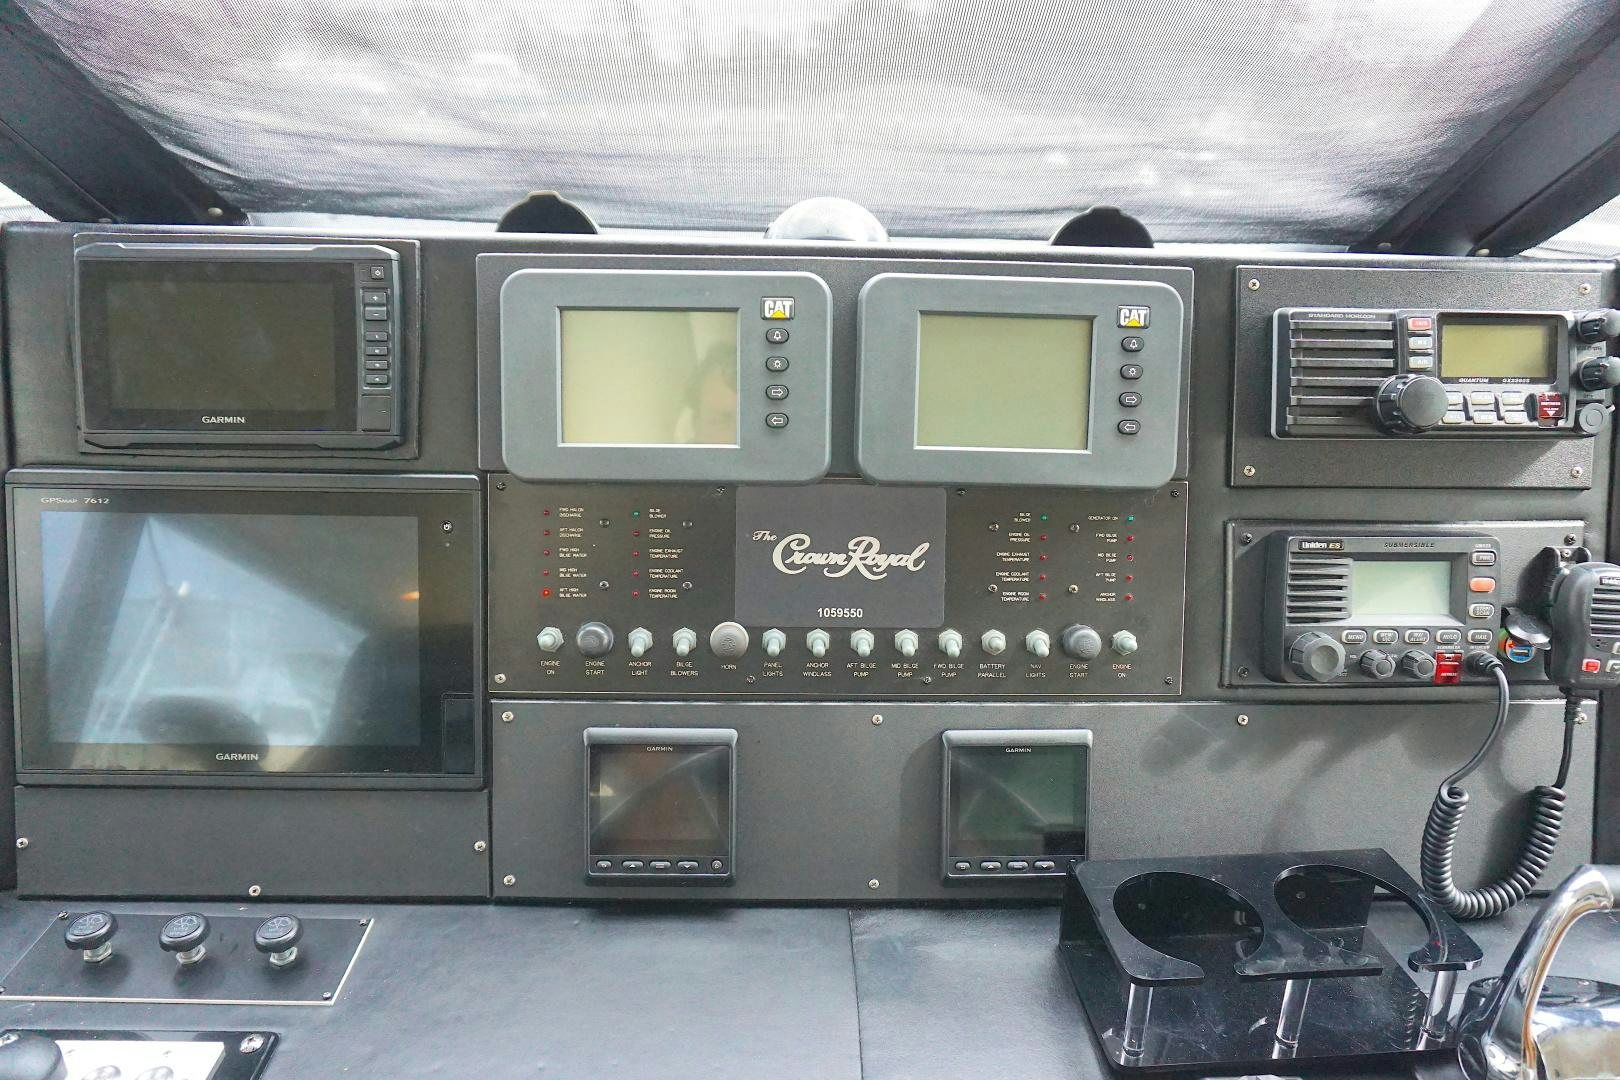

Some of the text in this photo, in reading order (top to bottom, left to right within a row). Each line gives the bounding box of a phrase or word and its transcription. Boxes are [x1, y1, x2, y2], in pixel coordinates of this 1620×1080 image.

[764, 300, 792, 318] CAT
[1120, 308, 1146, 326] CAT
[202, 416, 244, 424] GARMIN
[752, 530, 930, 580] The Crown Royal
[817, 608, 863, 618] 1059550
